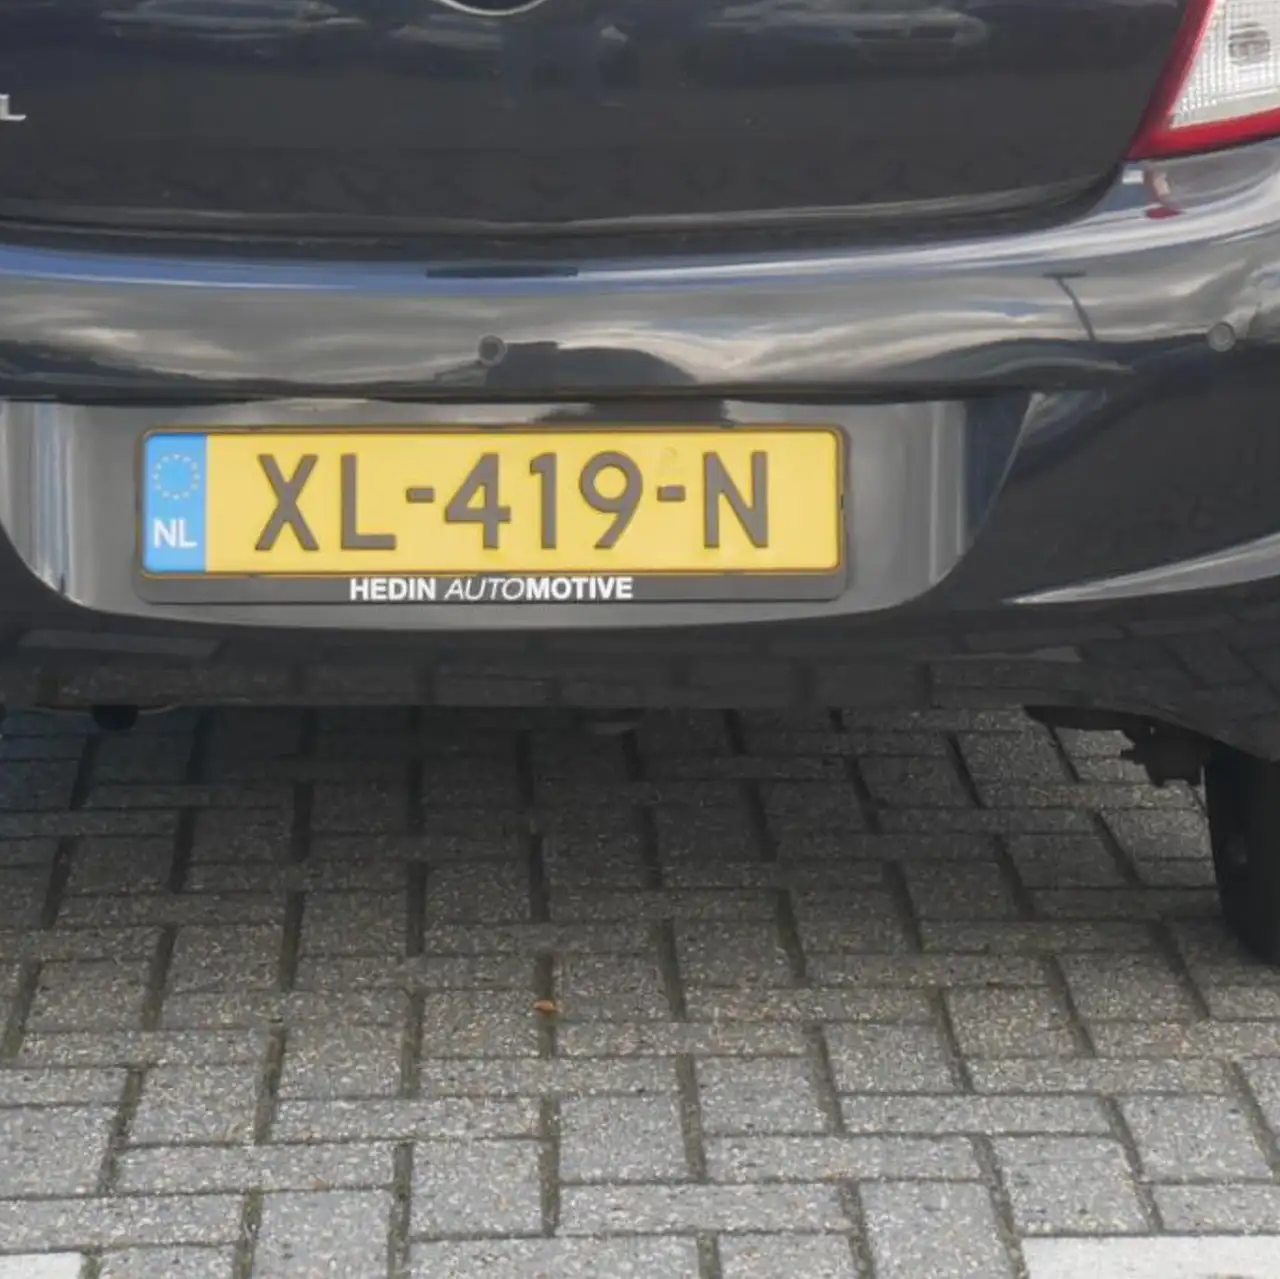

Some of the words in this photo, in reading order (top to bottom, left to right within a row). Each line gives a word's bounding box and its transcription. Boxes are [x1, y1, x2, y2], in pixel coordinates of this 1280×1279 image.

[254, 451, 769, 552] XL-419-N
[153, 519, 197, 549] NL
[350, 577, 436, 602] HEDIN
[445, 577, 634, 602] AUTOMOTIVE
